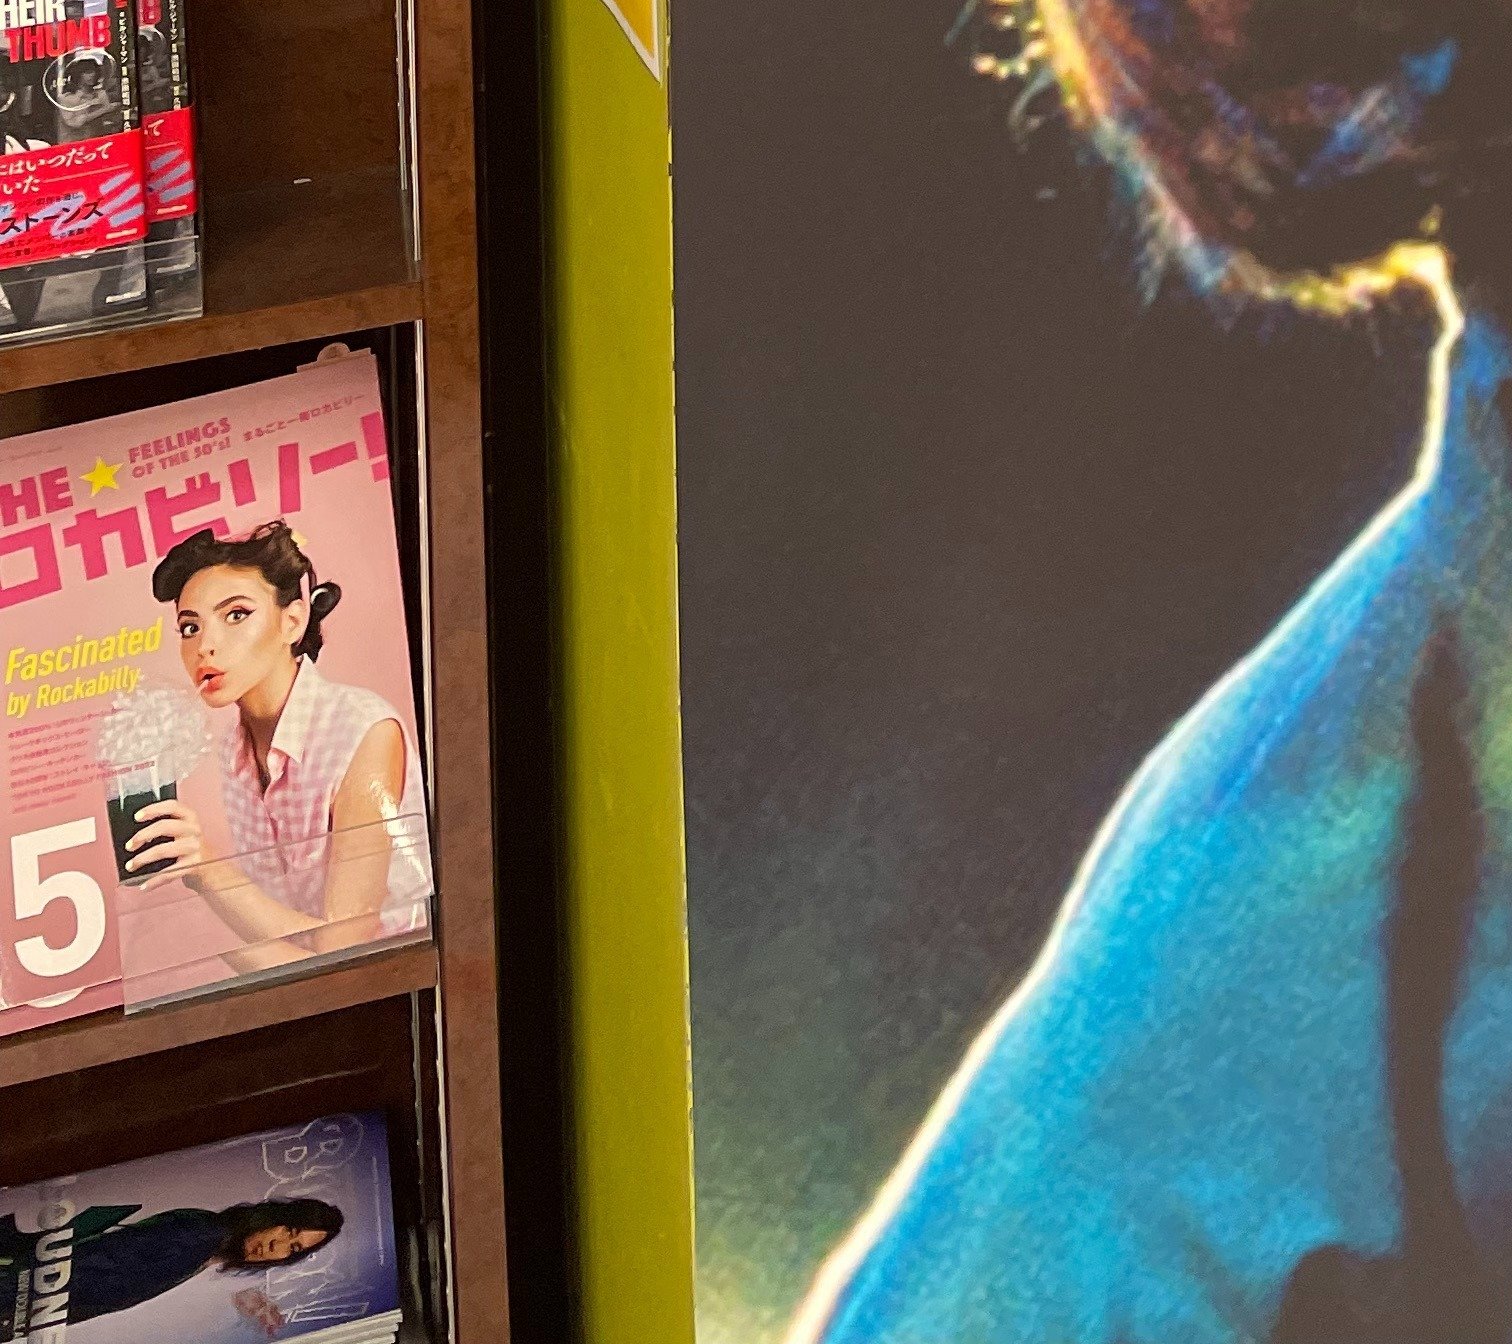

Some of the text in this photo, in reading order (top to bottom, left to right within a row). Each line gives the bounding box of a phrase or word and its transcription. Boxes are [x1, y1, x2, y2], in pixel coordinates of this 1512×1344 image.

[5, 14, 112, 64] THUMB
[127, 416, 231, 465] FEELINGS
[131, 461, 154, 480] OF
[158, 451, 190, 471] THE
[4, 615, 164, 686] Fascinated
[6, 664, 142, 719] by Rockabilly
[12, 816, 107, 979] 5
